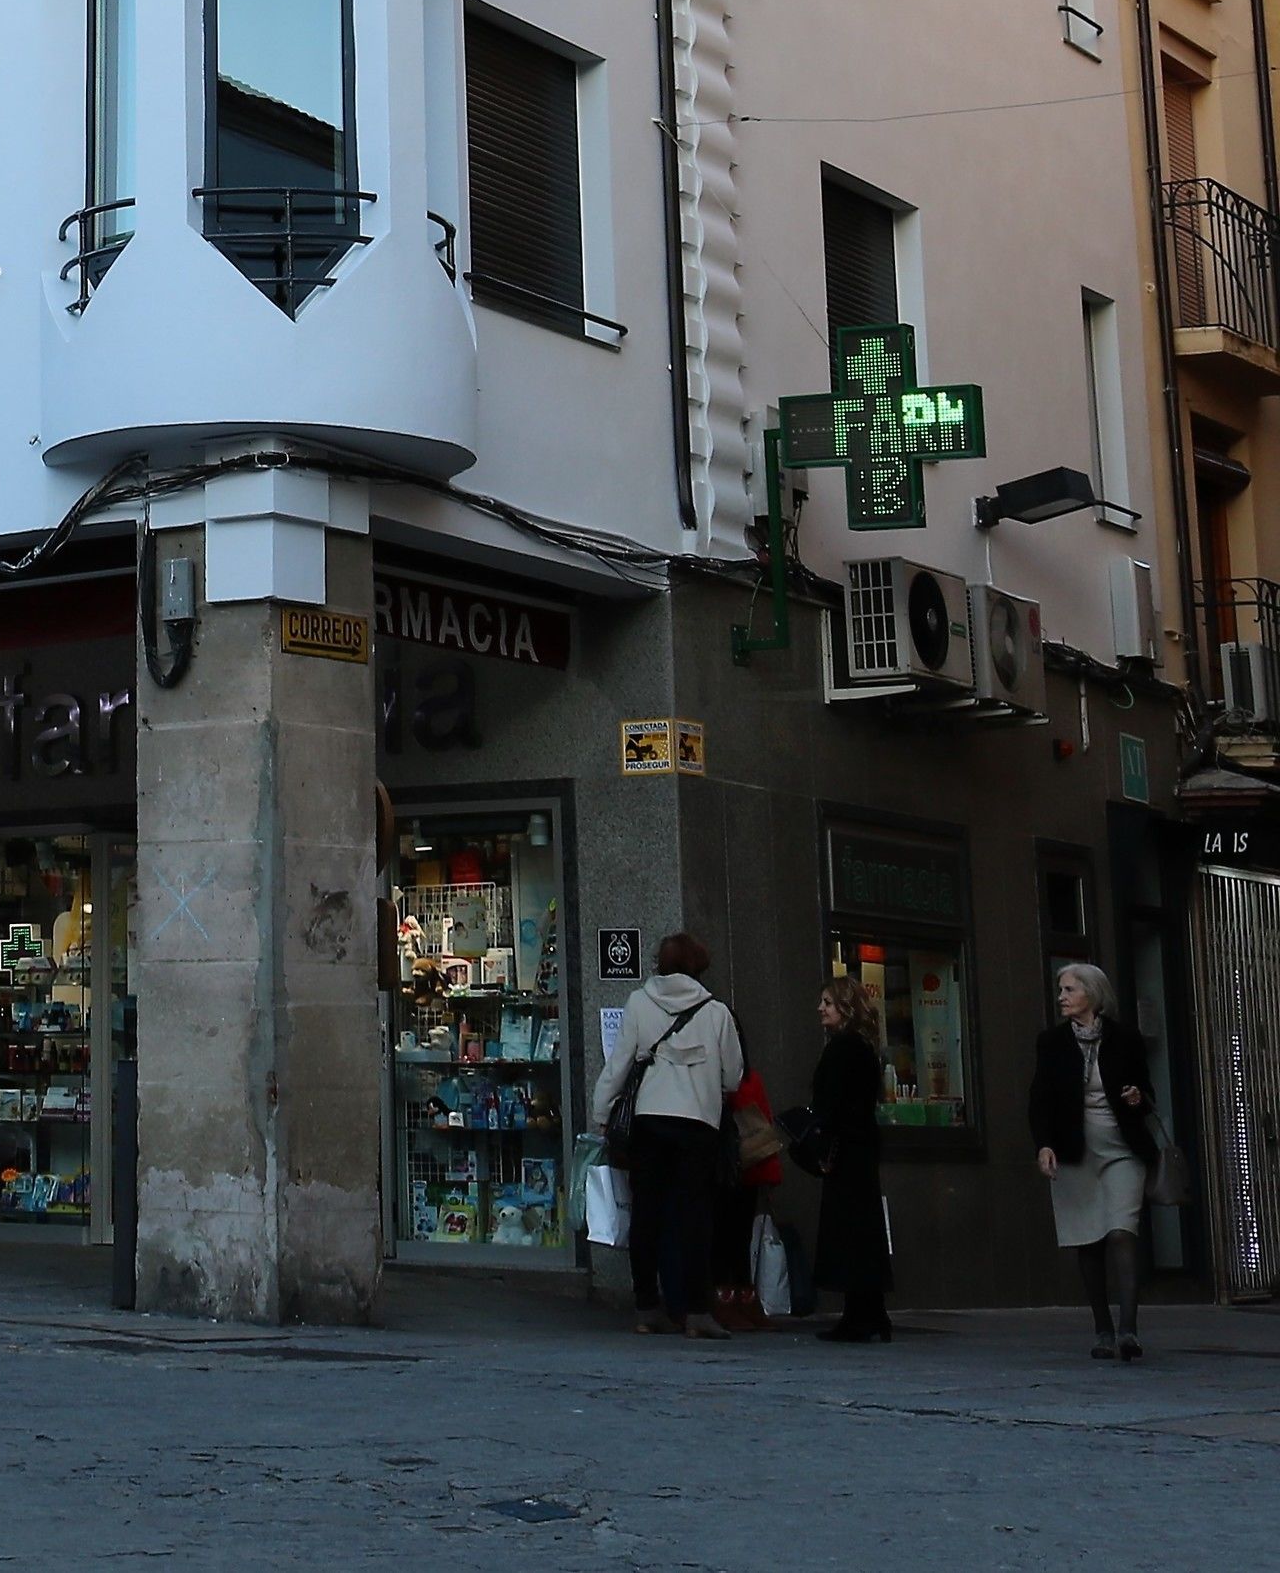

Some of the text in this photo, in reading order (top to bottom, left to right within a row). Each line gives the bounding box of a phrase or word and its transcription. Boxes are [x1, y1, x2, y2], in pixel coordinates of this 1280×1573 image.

[289, 611, 362, 647] CORREOS
[374, 583, 541, 663] RMACIA
[625, 761, 670, 770] PROSEGUR
[1204, 832, 1249, 853] LA IS
[603, 1012, 624, 1020] RAST
